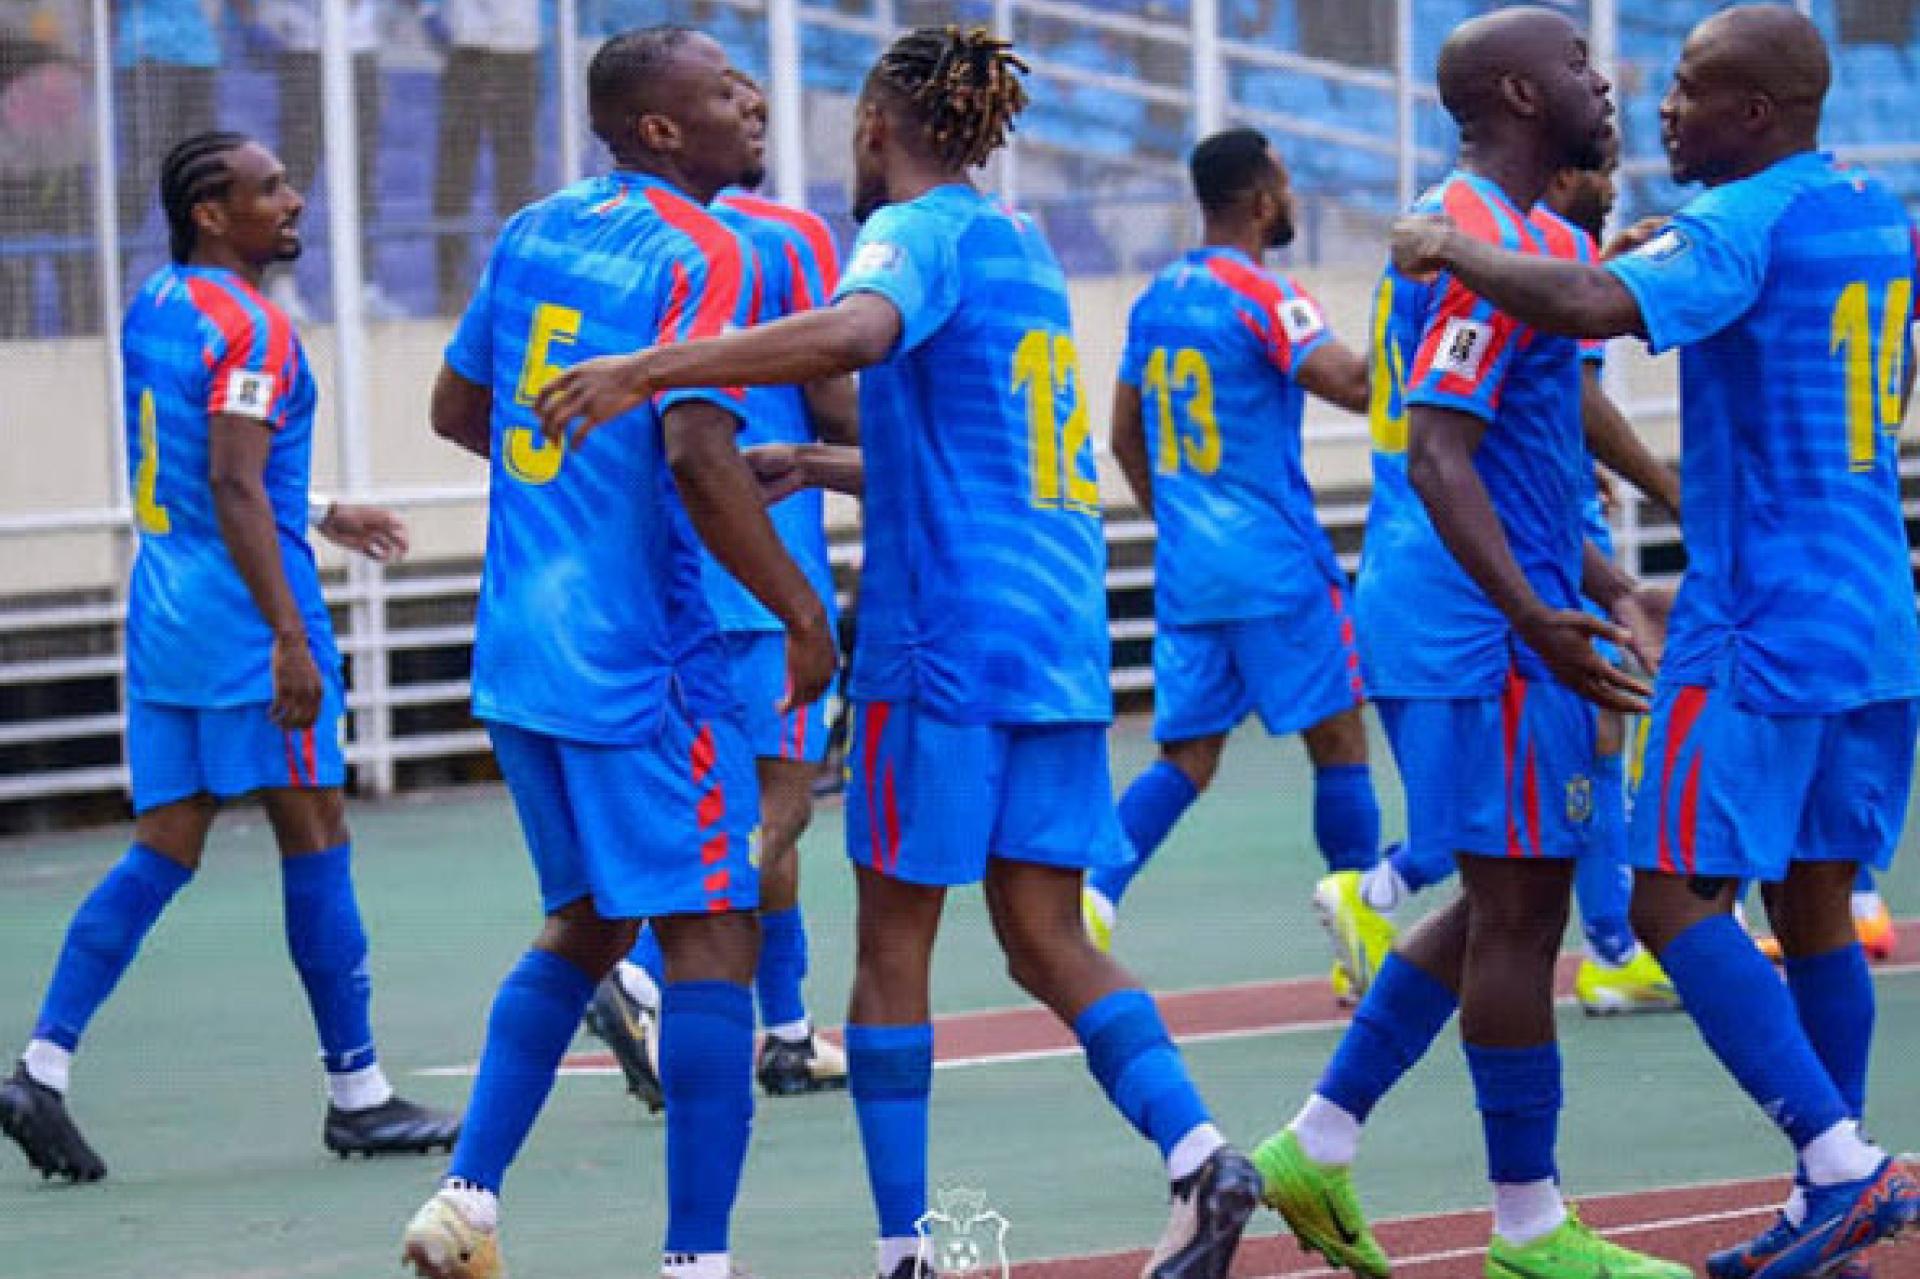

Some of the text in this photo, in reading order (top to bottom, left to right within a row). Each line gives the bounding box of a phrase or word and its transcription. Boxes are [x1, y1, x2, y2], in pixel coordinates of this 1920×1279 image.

[503, 302, 583, 486] 5
[1011, 328, 1102, 517] 12
[1142, 346, 1222, 476] 13
